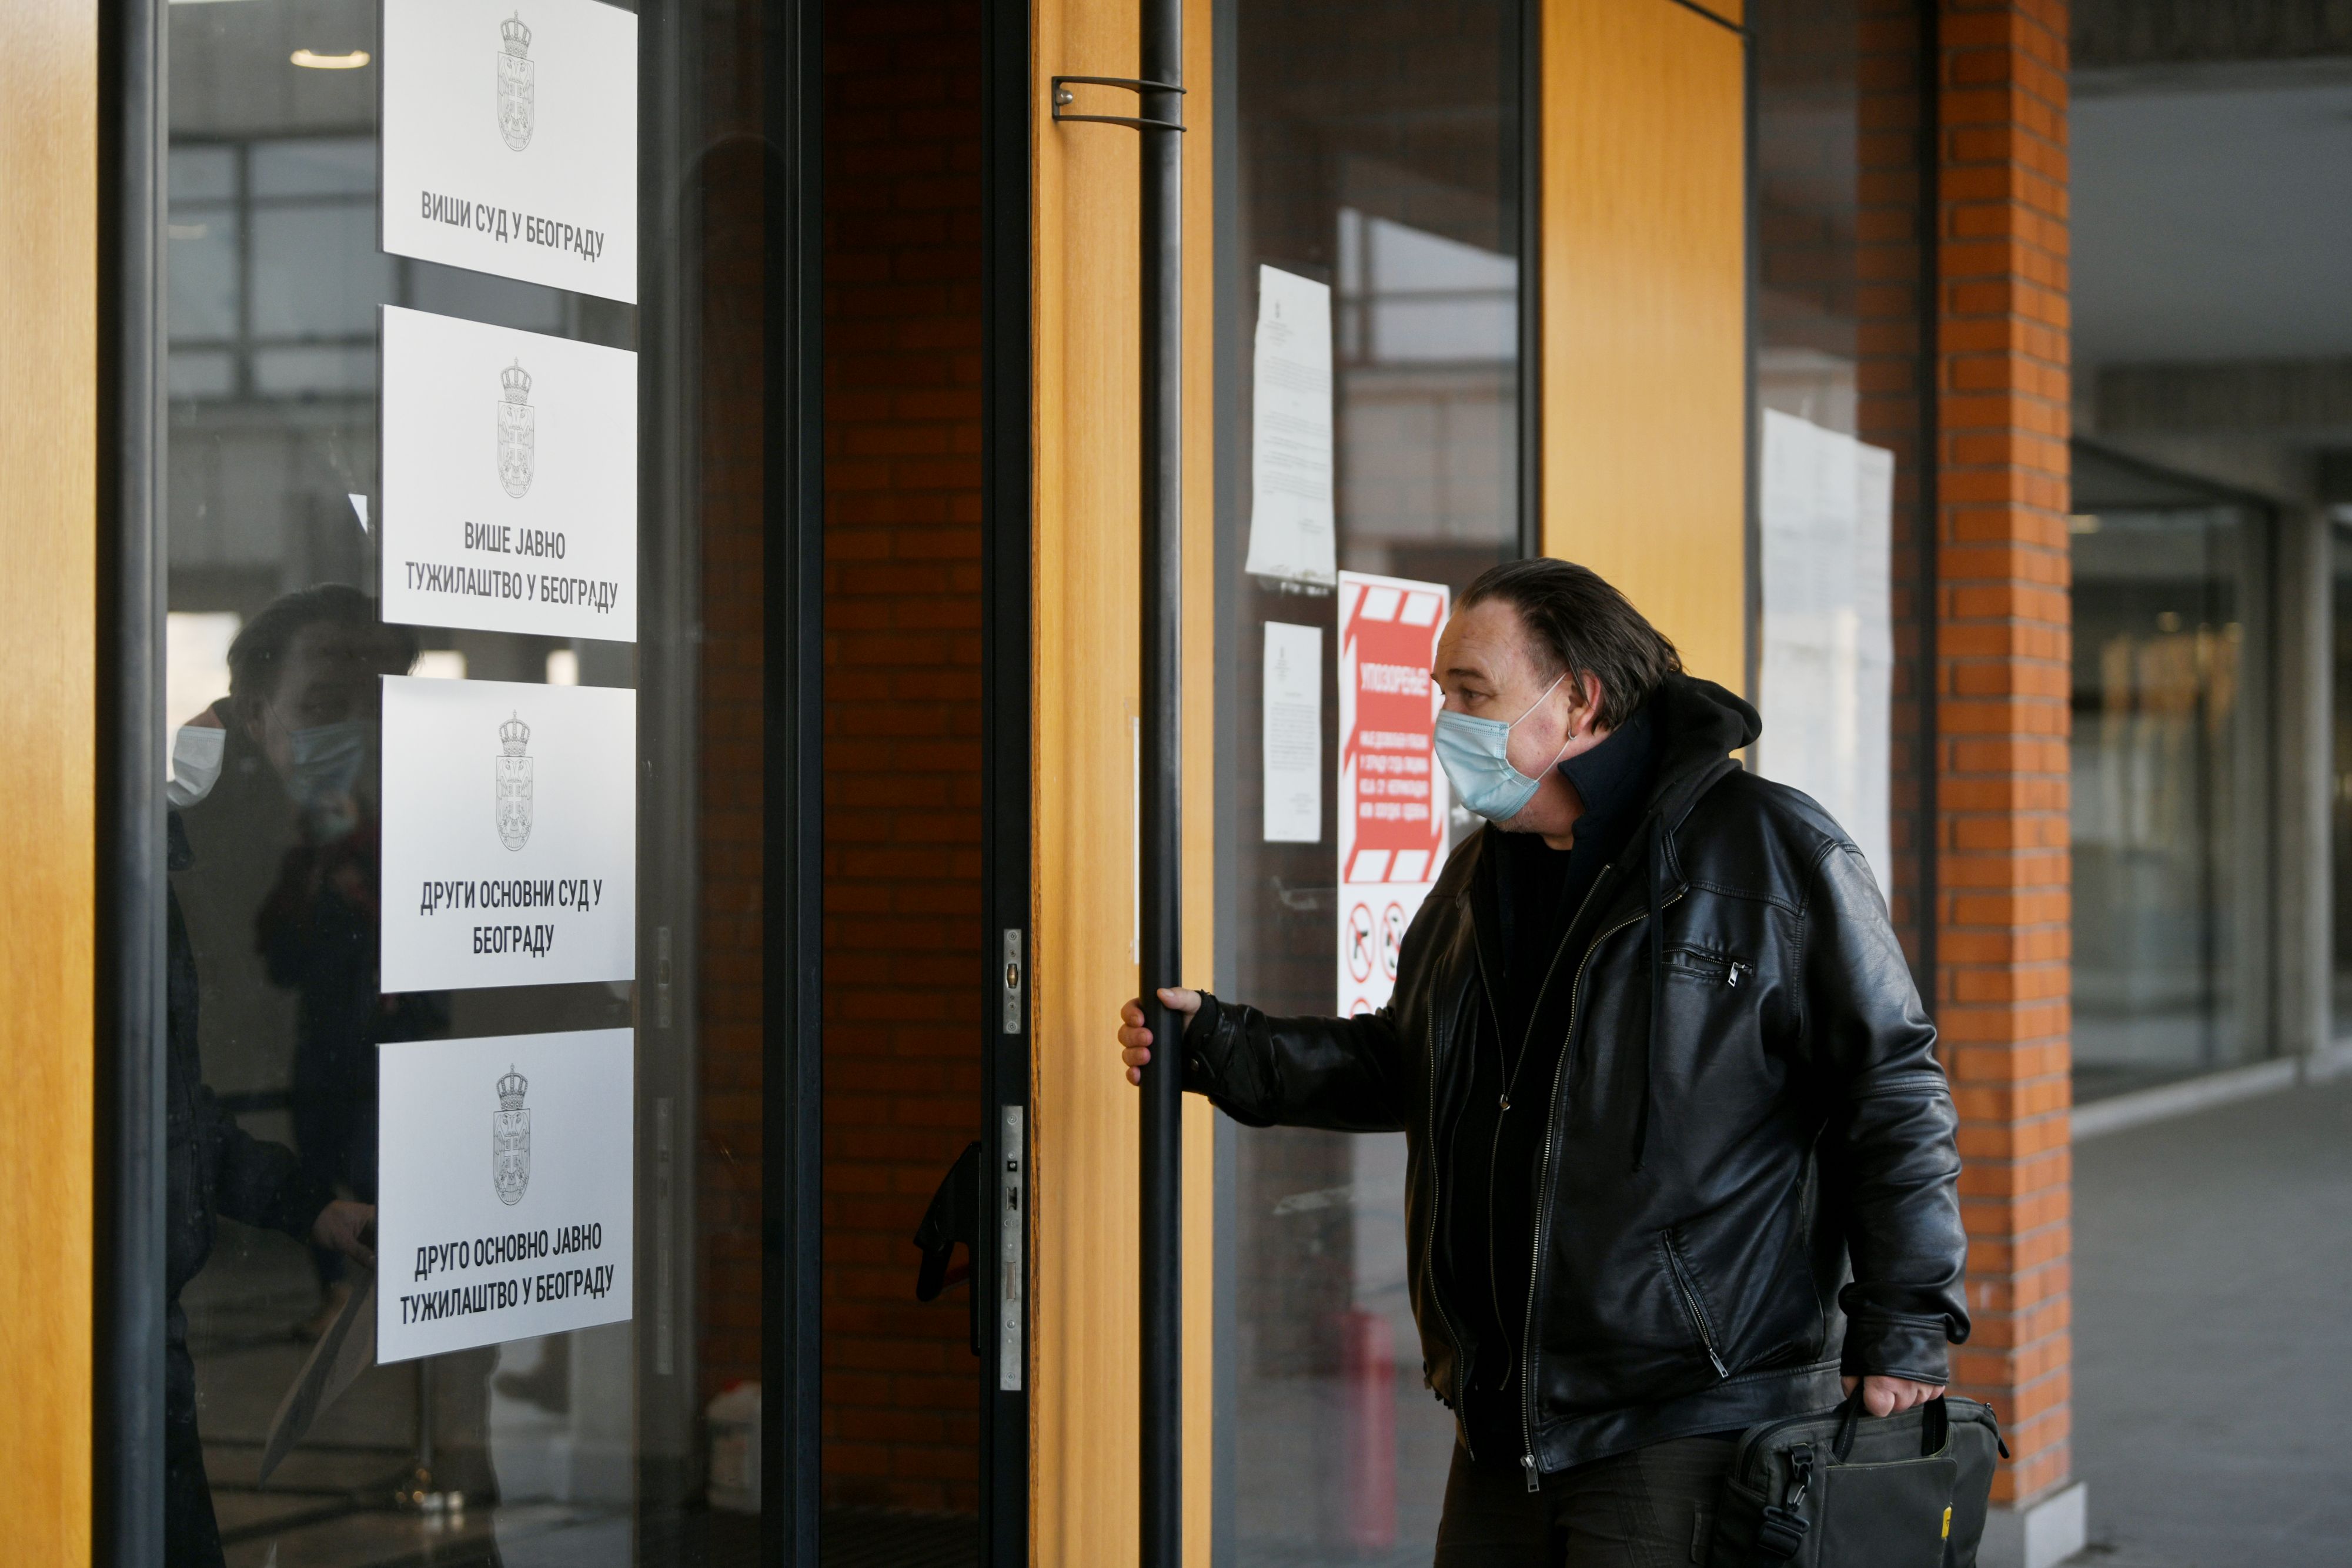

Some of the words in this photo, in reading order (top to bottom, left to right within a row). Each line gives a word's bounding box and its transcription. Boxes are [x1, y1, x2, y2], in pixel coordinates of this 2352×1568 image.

[422, 190, 470, 229] ВИШИ
[476, 203, 508, 243] СУД
[512, 212, 522, 239] У
[526, 215, 604, 263] БЕОГРАДУ
[465, 521, 511, 554] ВИШЕ
[515, 528, 566, 560] ЈАВНО
[405, 561, 522, 600] ТУЖИЛАШТВО
[526, 573, 536, 601] У
[541, 575, 618, 614] БЕОГРАДУ
[420, 881, 475, 916] ДРУГИ
[480, 880, 554, 908] ОСНОВНИ
[559, 879, 590, 912] СУД
[593, 879, 603, 906] У
[473, 924, 554, 958] БЕОГРАДУ
[414, 1241, 470, 1282] ДРУГО
[474, 1229, 549, 1267] ОСНОВНО
[552, 1222, 602, 1256] ЈАВНО
[400, 1279, 518, 1325] ТУЖИЛАШТВО
[522, 1276, 533, 1305] У
[536, 1263, 614, 1303] БЕОГРАДУ
